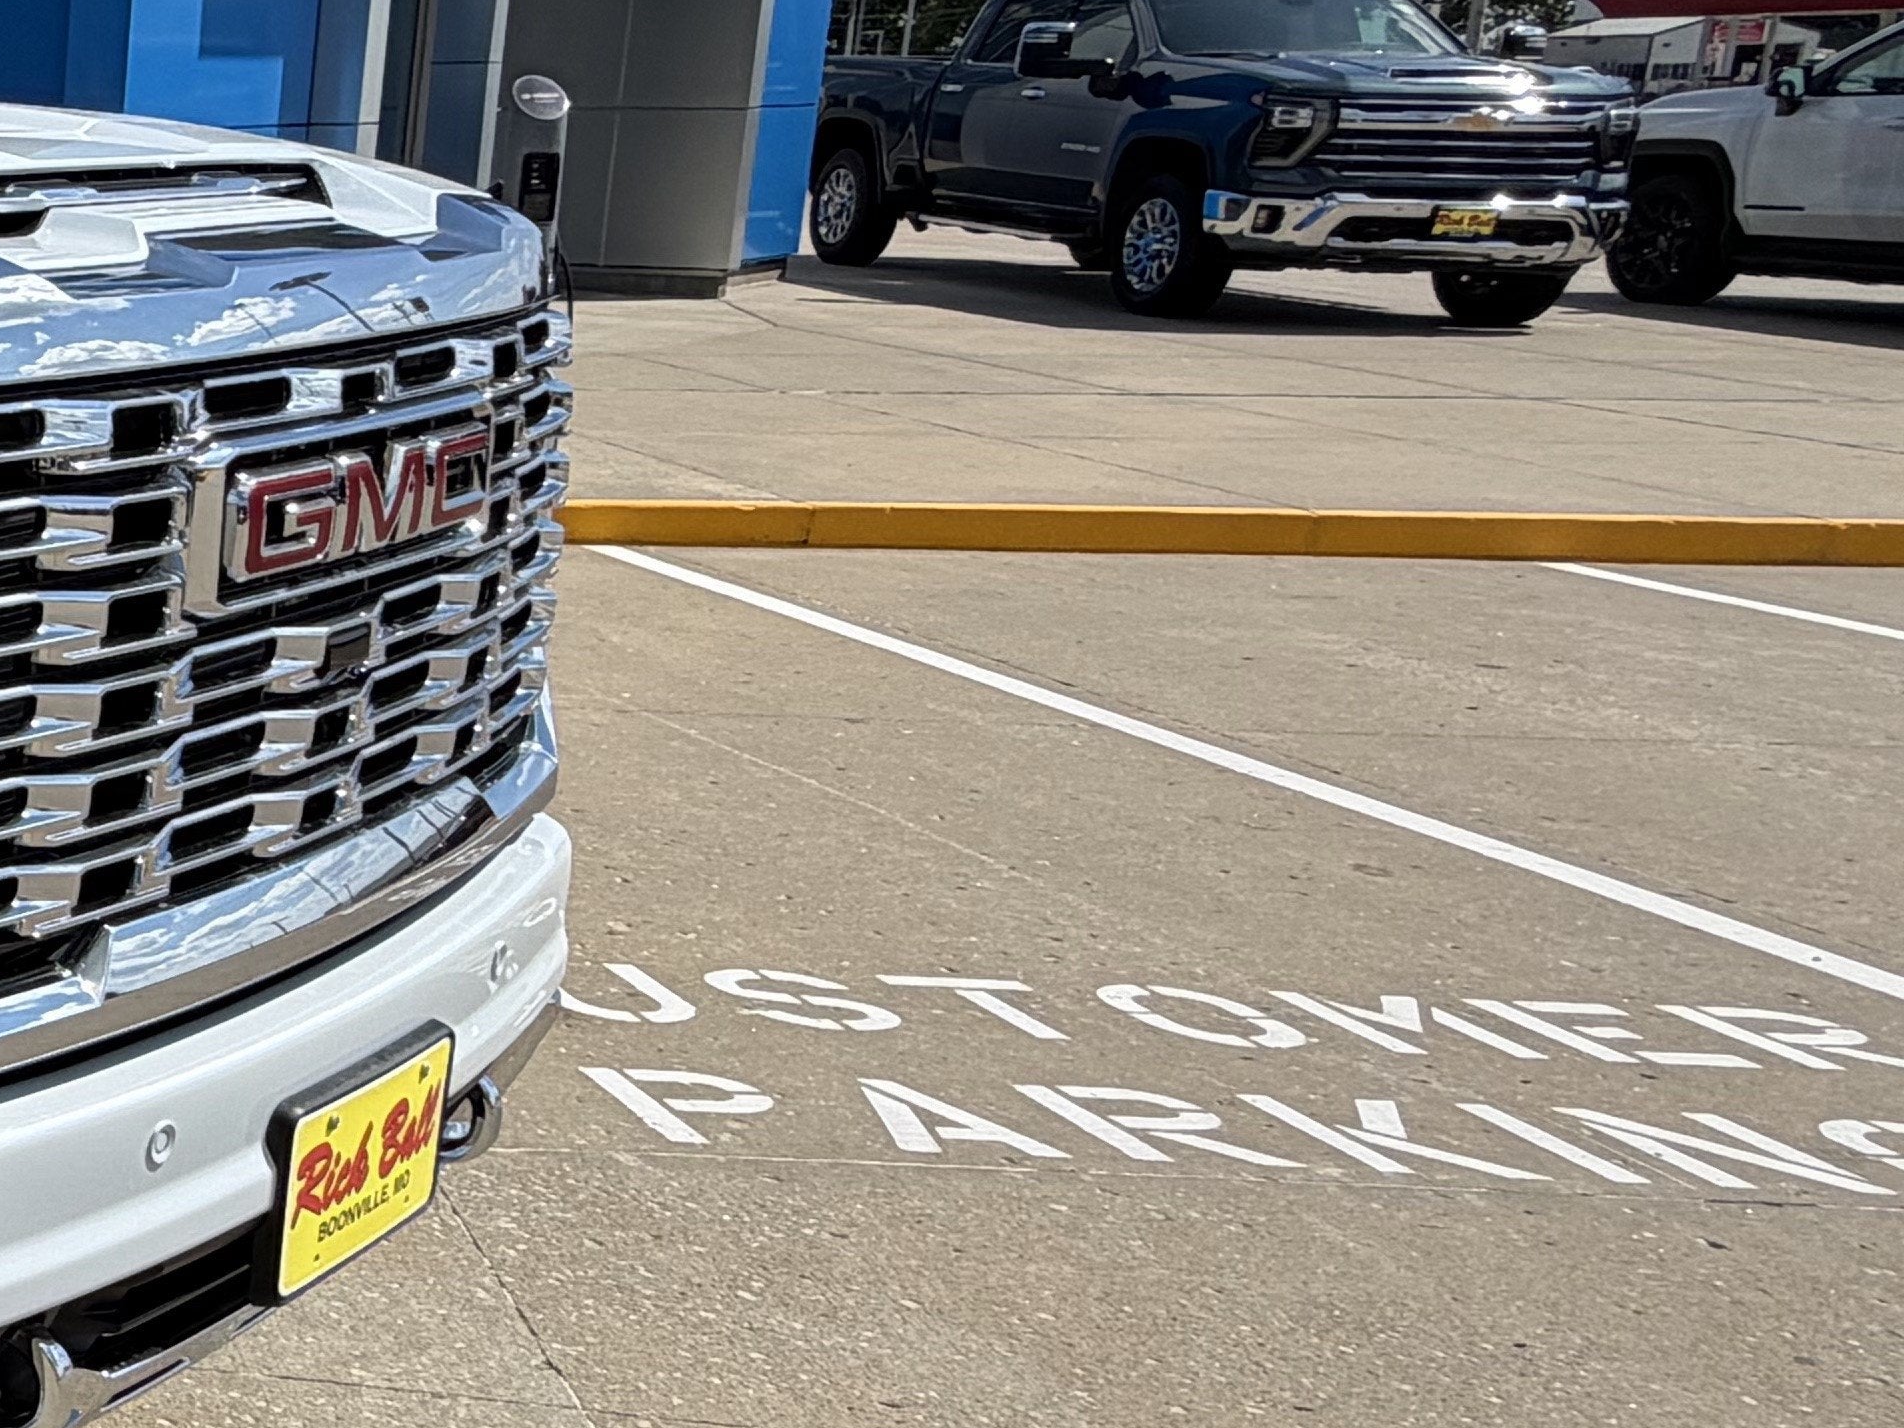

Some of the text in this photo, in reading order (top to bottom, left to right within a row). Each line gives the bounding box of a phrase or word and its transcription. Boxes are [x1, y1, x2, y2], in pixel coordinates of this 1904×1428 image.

[232, 425, 489, 579] GMC
[559, 962, 1904, 1070] USTOMER
[291, 1078, 441, 1230] Rick Ball
[392, 1169, 411, 1196] MO
